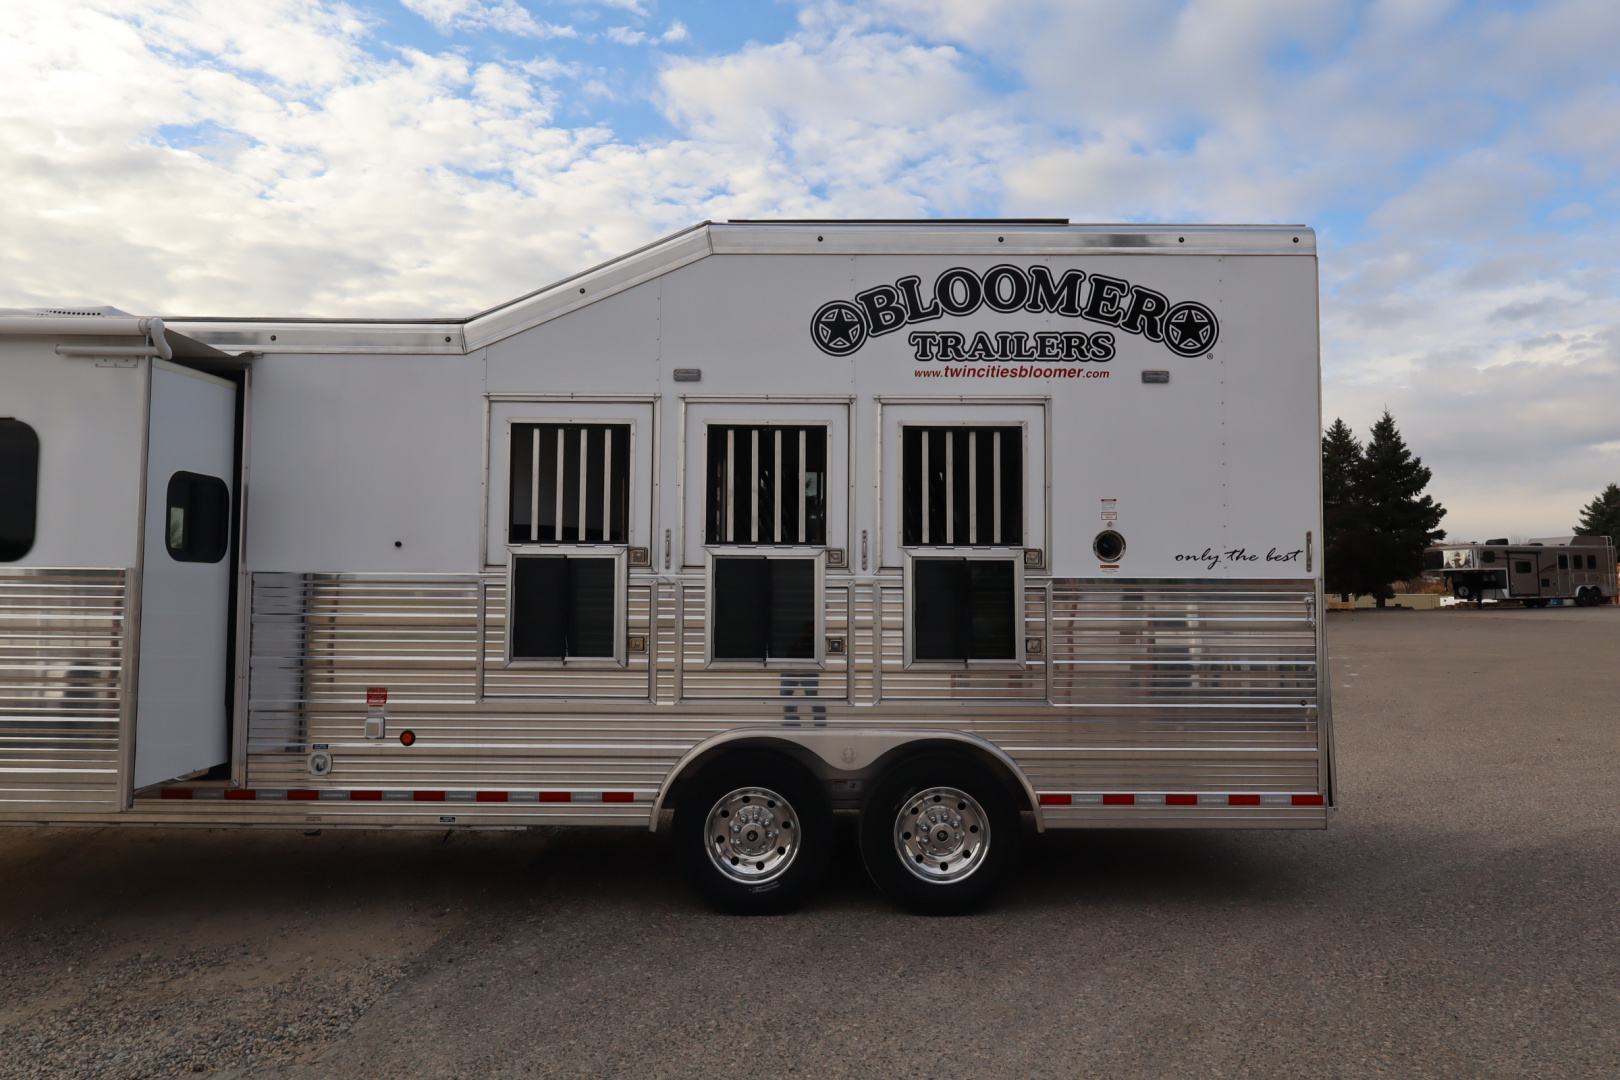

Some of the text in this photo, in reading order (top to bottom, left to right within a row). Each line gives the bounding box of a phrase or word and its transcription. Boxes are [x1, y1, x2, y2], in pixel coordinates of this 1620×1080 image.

[856, 264, 1170, 342] BLOOMER
[908, 331, 1115, 362] TRAILERS
[914, 365, 1110, 379] www.twincitiesbloomer.com
[1174, 547, 1304, 570] only the best
